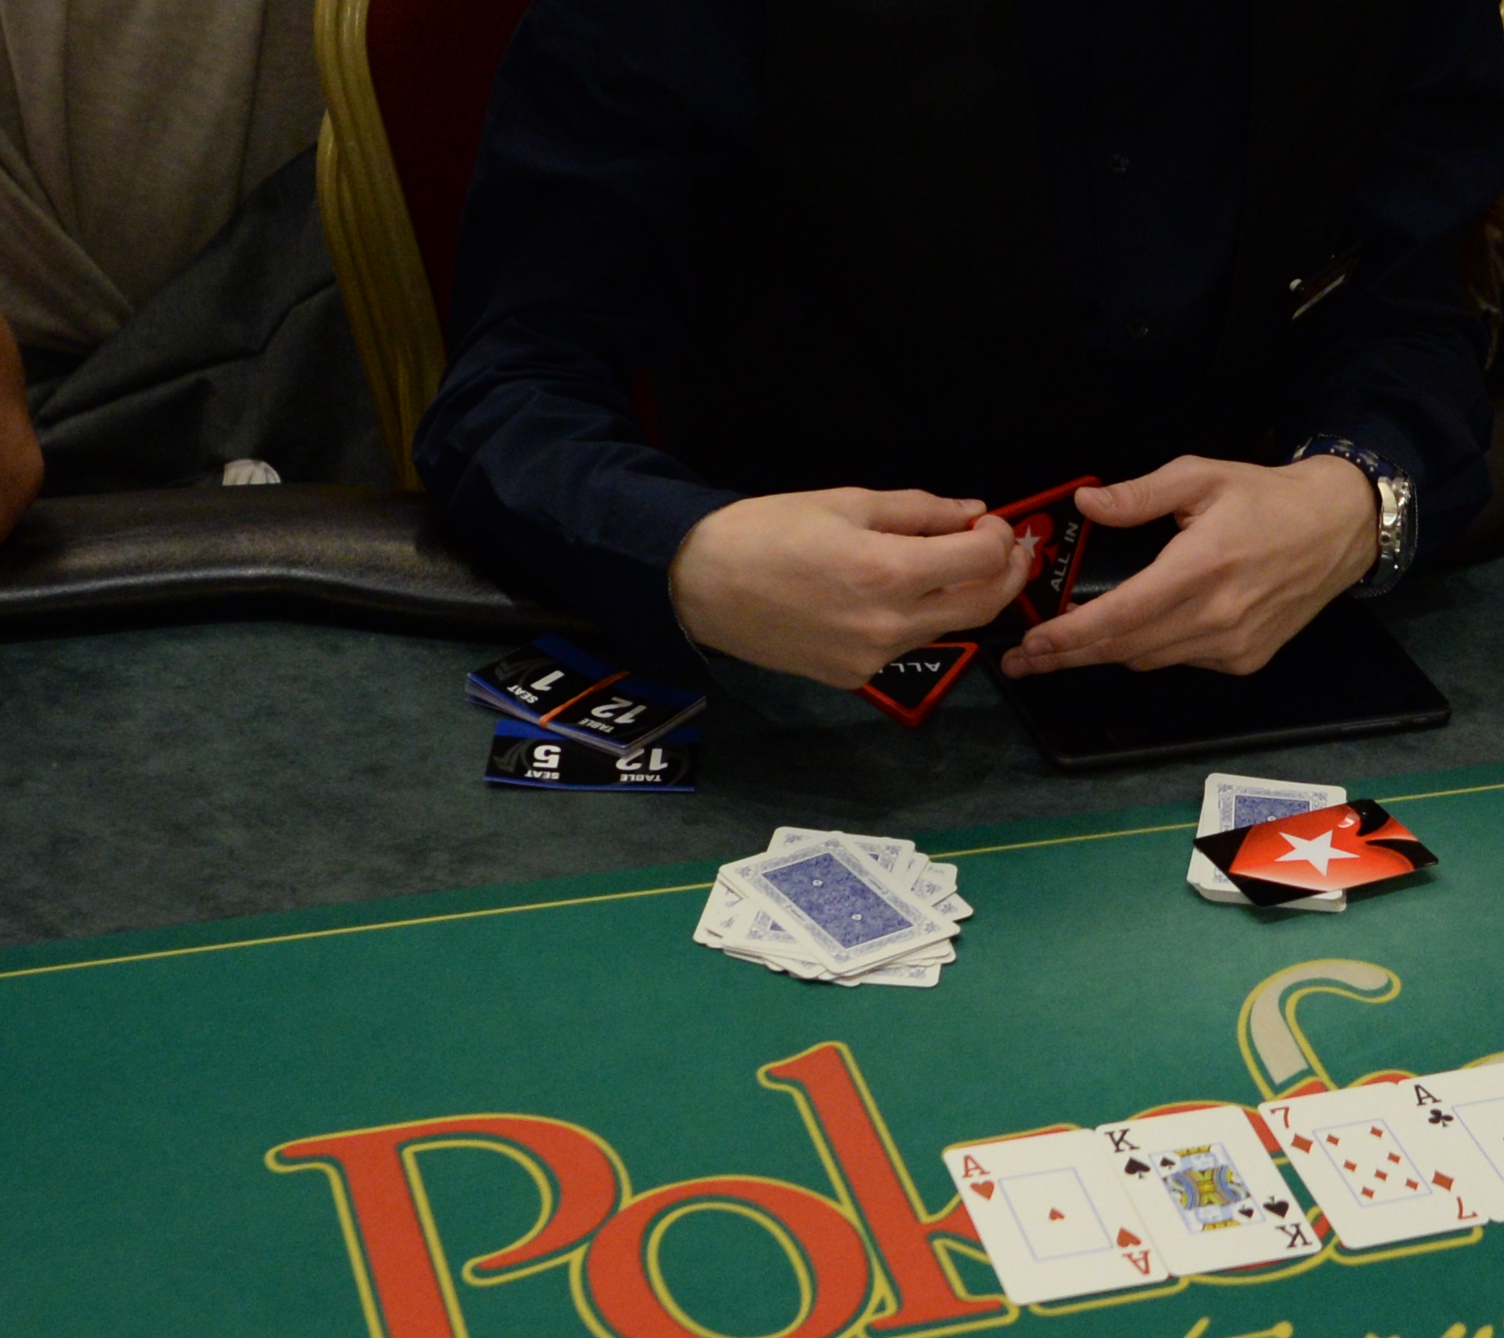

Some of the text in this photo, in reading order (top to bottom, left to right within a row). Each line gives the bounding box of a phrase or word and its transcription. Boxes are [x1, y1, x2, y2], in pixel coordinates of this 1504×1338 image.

[1049, 521, 1080, 593] ALL IN
[890, 661, 942, 674] ALL
[530, 669, 565, 692] 1
[507, 684, 539, 705] SEAT
[590, 696, 647, 725] 12
[577, 717, 615, 734] TABLE
[532, 744, 562, 769] 5
[524, 769, 561, 781] SEAT
[619, 773, 663, 783] TABLE
[1413, 1083, 1442, 1107] A
[1269, 1105, 1291, 1129] 7
[1104, 1128, 1141, 1154] K
[962, 1154, 990, 1179] A
[1455, 1195, 1479, 1221] 7
[1275, 1222, 1313, 1249] K
[1122, 1249, 1151, 1276] A
